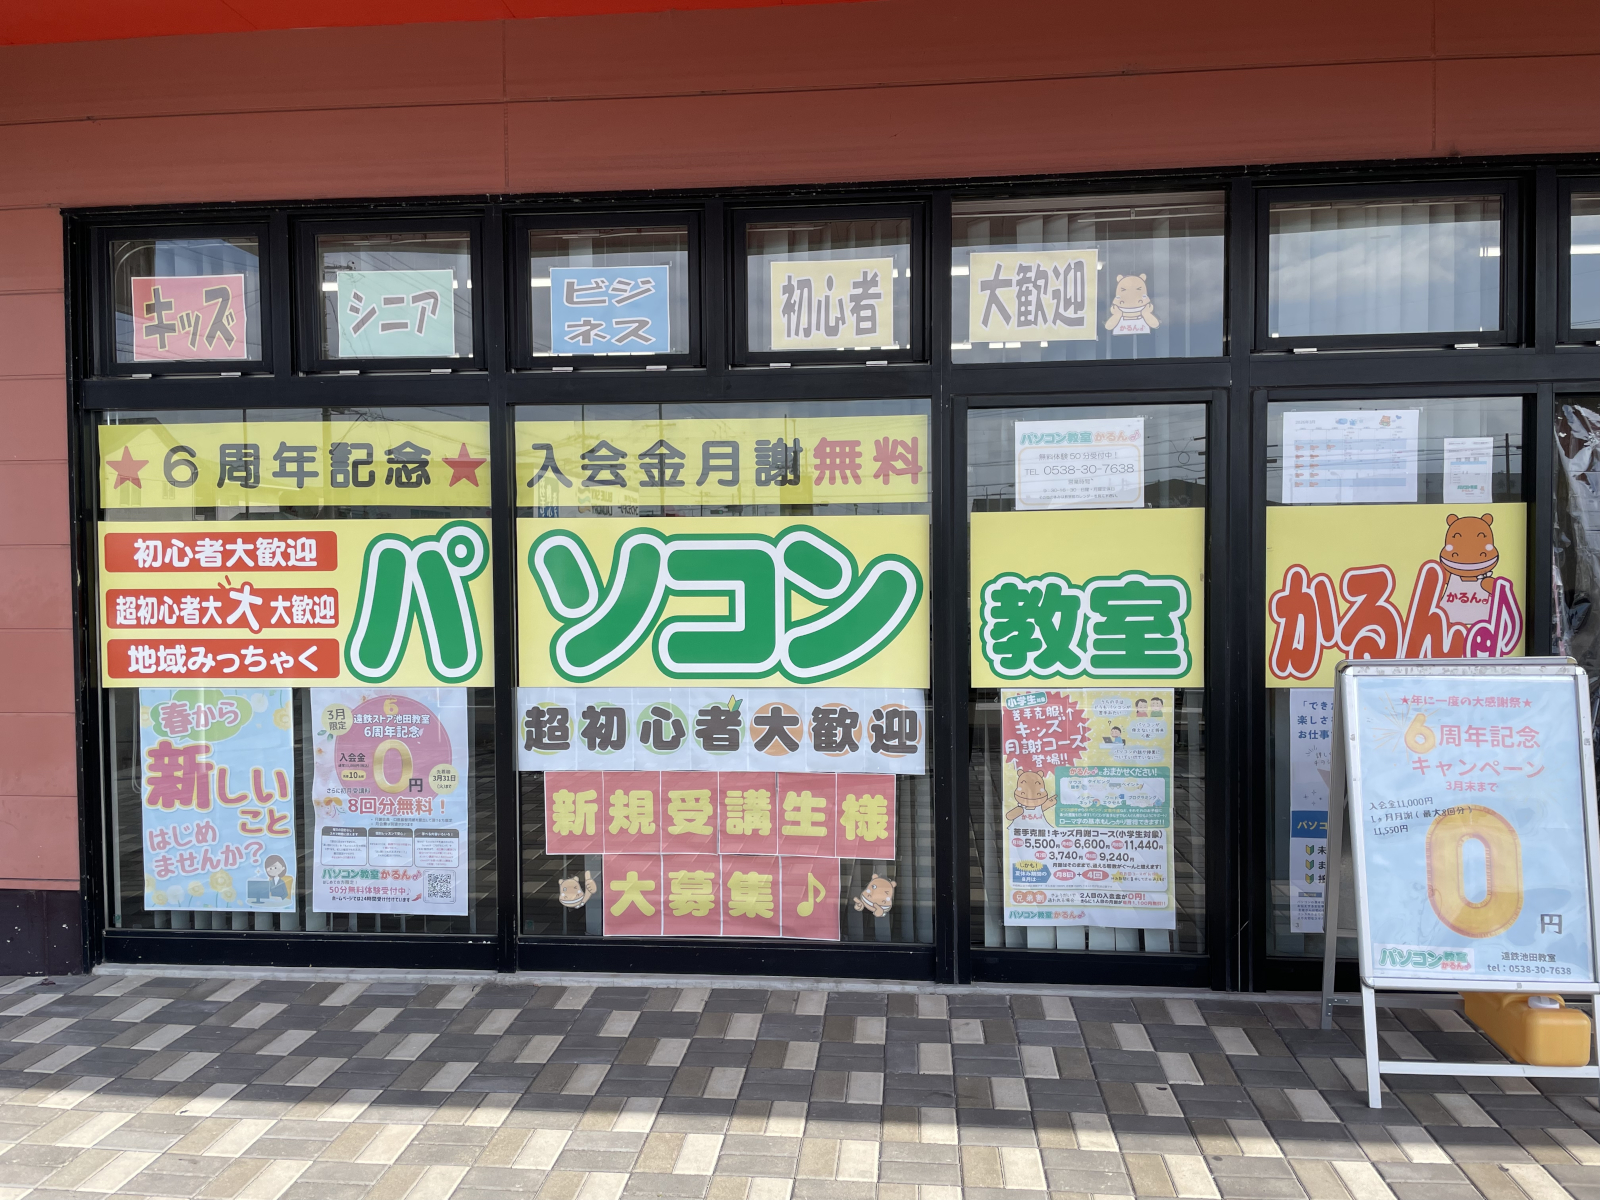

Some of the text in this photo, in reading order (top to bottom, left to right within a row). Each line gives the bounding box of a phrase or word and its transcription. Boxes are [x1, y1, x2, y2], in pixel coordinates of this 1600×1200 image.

[562, 277, 657, 308] ビジ
[780, 270, 883, 338] 初心者
[978, 259, 1087, 330] 大歓迎
[143, 285, 238, 352] キッズ
[346, 289, 441, 337] シニア
[563, 318, 657, 347] ネス
[163, 441, 432, 489] 6周年記念
[526, 436, 923, 488] 入会金月謝無料
[1025, 463, 1135, 476] TEL 0538-30-7638
[133, 537, 318, 568] 初心者大歓迎
[1446, 591, 1484, 605] かるん
[127, 644, 318, 674] 地域みっちゃく
[160, 701, 240, 736] 春から
[327, 709, 345, 720] 3月
[329, 721, 346, 730] 限定
[353, 714, 430, 724] 遠鉄ストア池田教室
[1015, 716, 1066, 738] キッズ
[364, 726, 420, 738] 6周年記念
[523, 704, 920, 755] 超初心者大歓迎
[1298, 730, 1332, 740] お仕事
[339, 753, 366, 762] 入会金
[1005, 735, 1085, 755] 月謝コース
[146, 740, 290, 810] 新しい
[373, 740, 423, 794] 0 円
[1411, 756, 1546, 779] キャンペーン
[1446, 780, 1499, 793] 3月末まで
[348, 797, 445, 816] 8回分無料！
[552, 788, 889, 841] 新規受講生様
[1369, 796, 1434, 811] 入会金11,000円
[148, 820, 218, 851] はじめ
[239, 807, 291, 836] こと
[1373, 824, 1409, 836] 11,550円
[154, 841, 264, 878] ませんか？
[1540, 913, 1563, 935] 円
